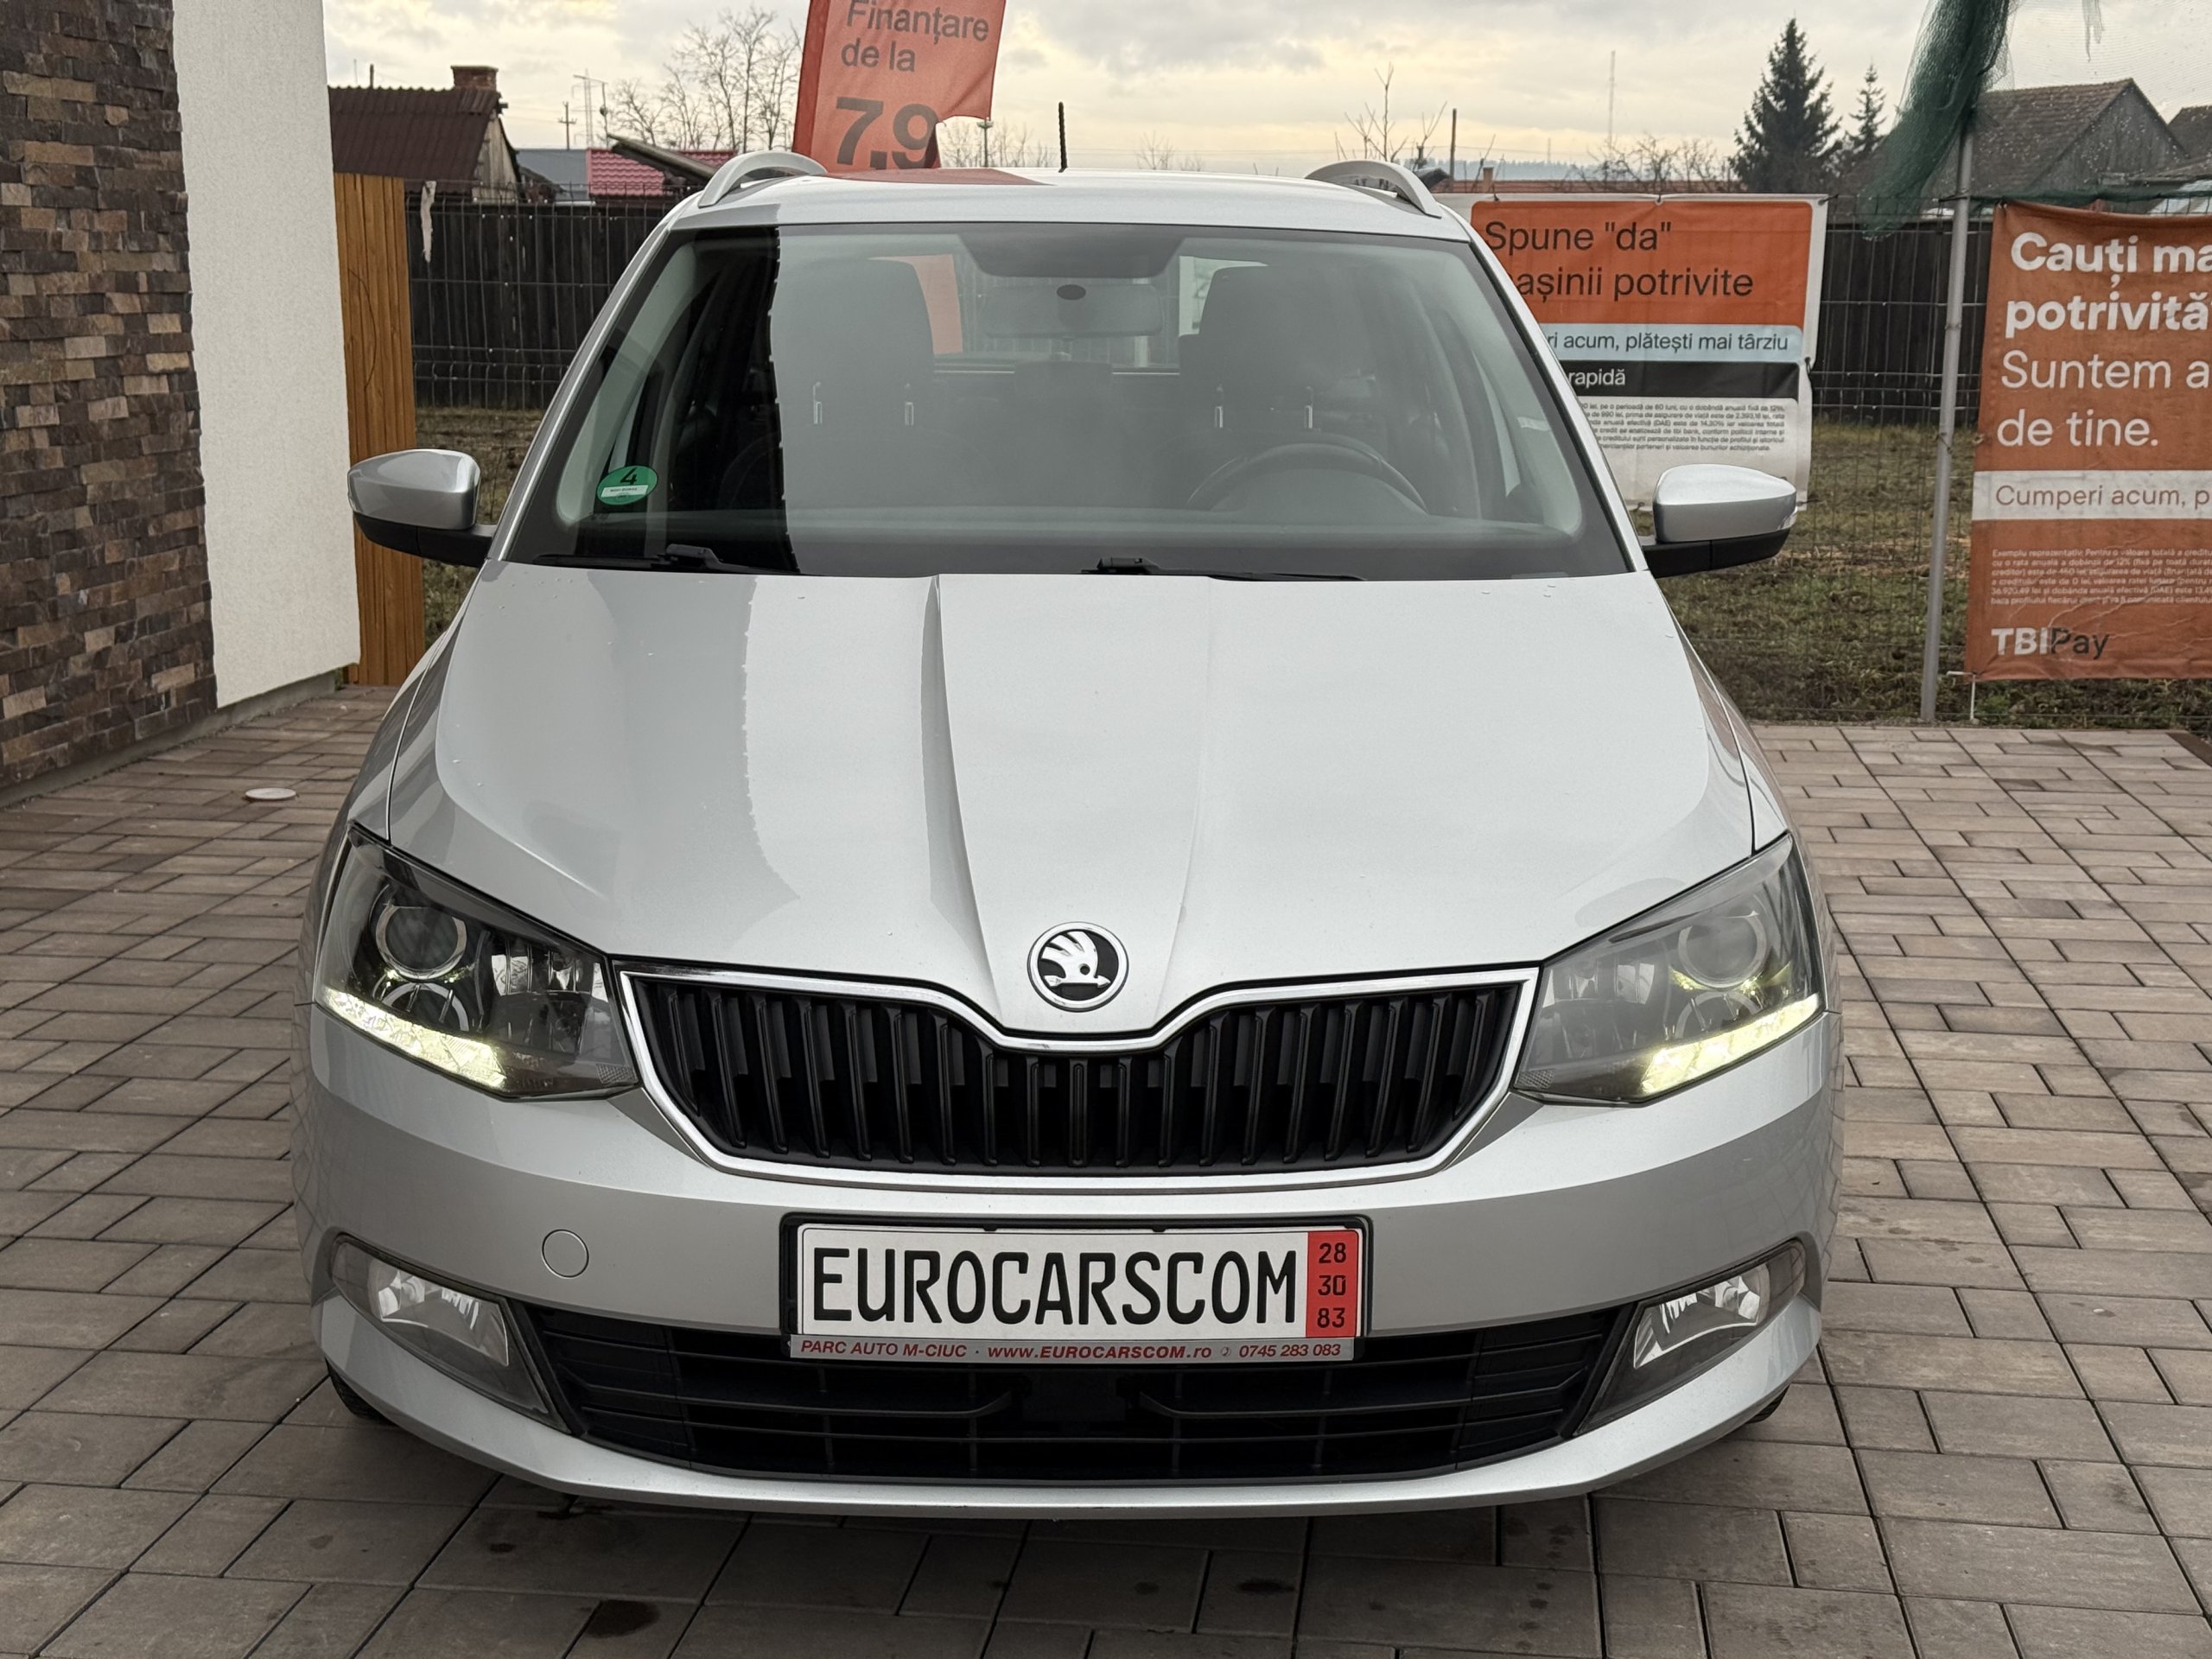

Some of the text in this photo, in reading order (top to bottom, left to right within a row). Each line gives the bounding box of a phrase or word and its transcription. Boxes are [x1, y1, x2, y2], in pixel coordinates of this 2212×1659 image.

[841, 38, 916, 73] de la
[1484, 221, 1671, 256] Spune "da"
[2011, 232, 2139, 288] Cauți
[1508, 266, 1753, 302] așinii potrivite
[2005, 291, 2212, 339] potrivită
[1563, 335, 1620, 352] acum,
[1626, 333, 1693, 353] plătești
[1699, 334, 1732, 350] mai
[1738, 333, 1789, 351] târziu
[1568, 368, 1626, 389] rapidă
[2001, 350, 2171, 389] Suntem
[1997, 409, 2158, 447] de tine.
[620, 467, 638, 485] 4
[1995, 485, 2103, 509] Cumperi
[2111, 489, 2186, 507] acum,
[1991, 626, 2110, 660] TBIPay
[1319, 1243, 1346, 1264] 28
[812, 1248, 1297, 1326] EUROCARSCOM
[1318, 1274, 1346, 1296] 30
[1317, 1307, 1345, 1328] 83
[801, 1340, 1341, 1359] PARC AUTO M-CIUC www.EUROCARSCOM.ro 0745 283 083
